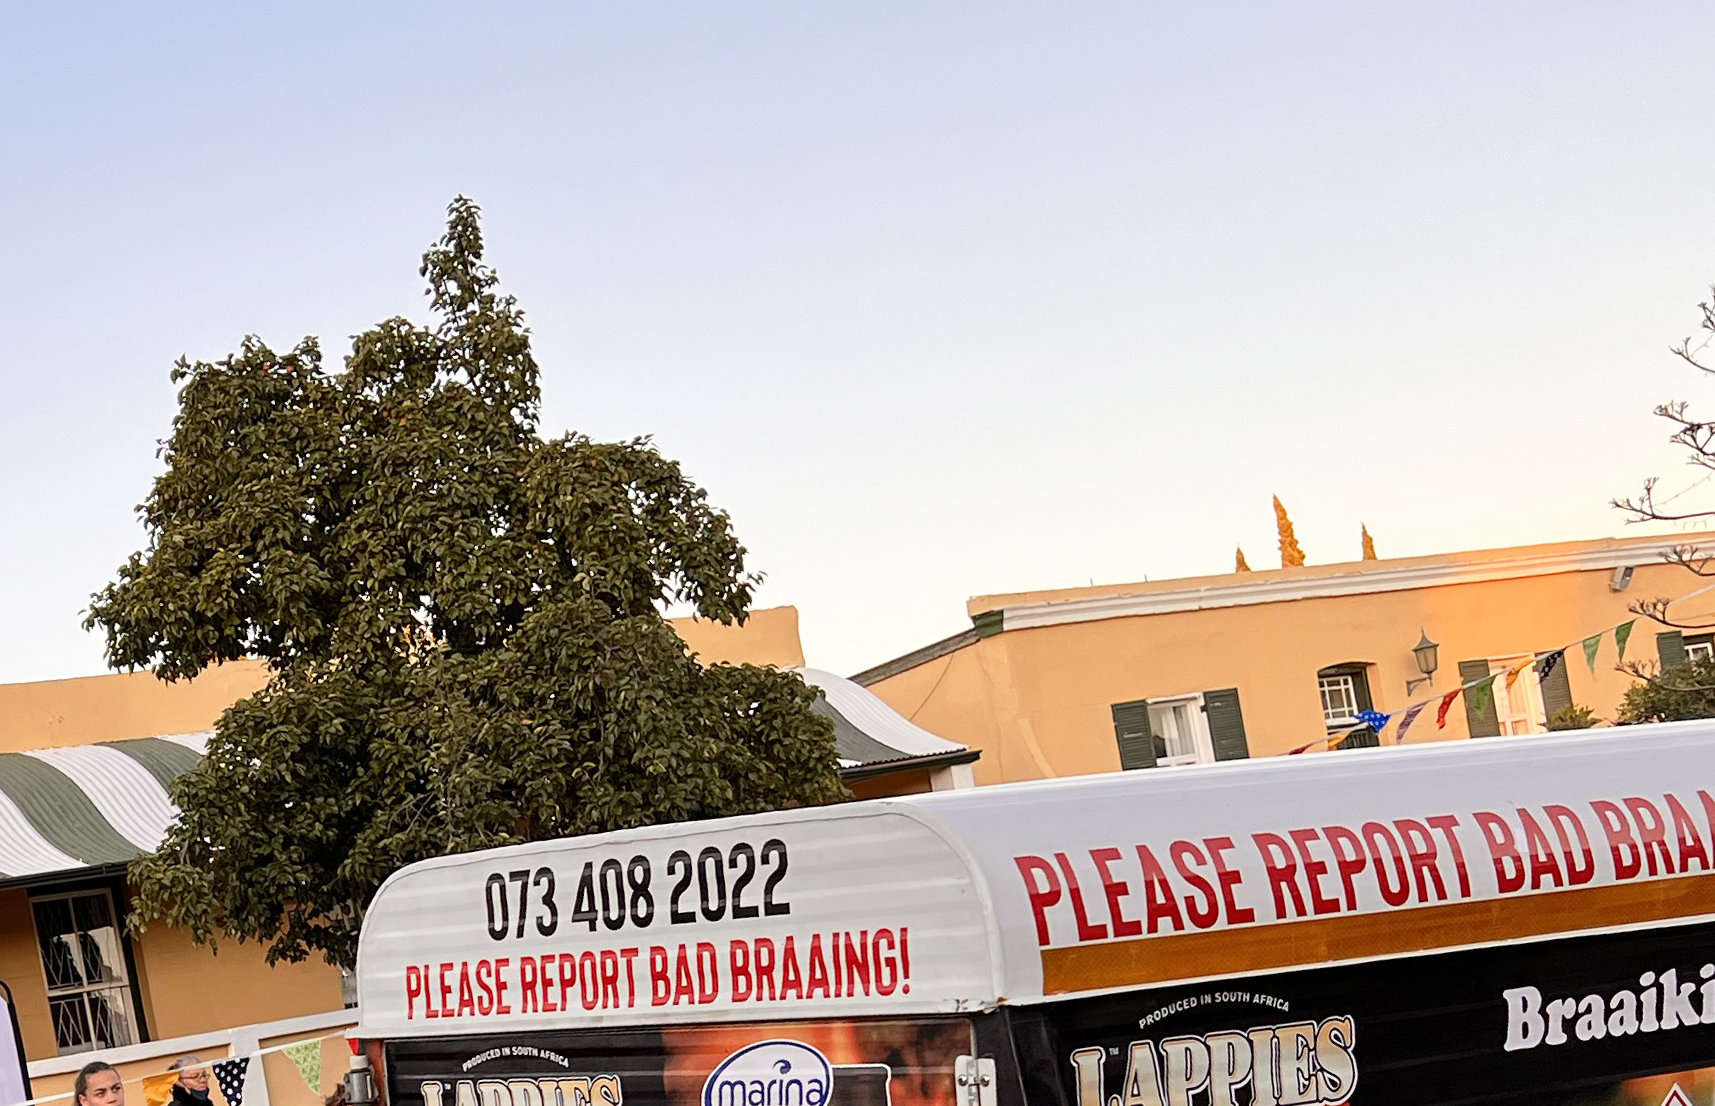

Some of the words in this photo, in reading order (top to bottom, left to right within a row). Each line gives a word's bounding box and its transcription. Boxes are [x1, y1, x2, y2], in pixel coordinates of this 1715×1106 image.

[485, 866, 559, 942] 073
[571, 854, 654, 932] 408
[667, 838, 790, 925] 2022
[1013, 836, 1255, 947] PLEASE
[1251, 814, 1473, 920] REPORT
[1473, 804, 1596, 894] BAD
[406, 960, 510, 1020] PLEASE
[521, 947, 639, 1014] REPORT
[648, 942, 718, 1005] BAD
[730, 926, 912, 998] BRAAING!
[1139, 998, 1197, 1029] PRODUCED
[1200, 994, 1212, 1005] IN
[1214, 991, 1250, 1003] SOUTH
[1252, 994, 1290, 1012] AFRICA
[462, 1048, 502, 1072] PRODUCED
[502, 1047, 511, 1056] IN
[512, 1046, 539, 1057] SOUTH
[540, 1049, 570, 1068] AFRICA
